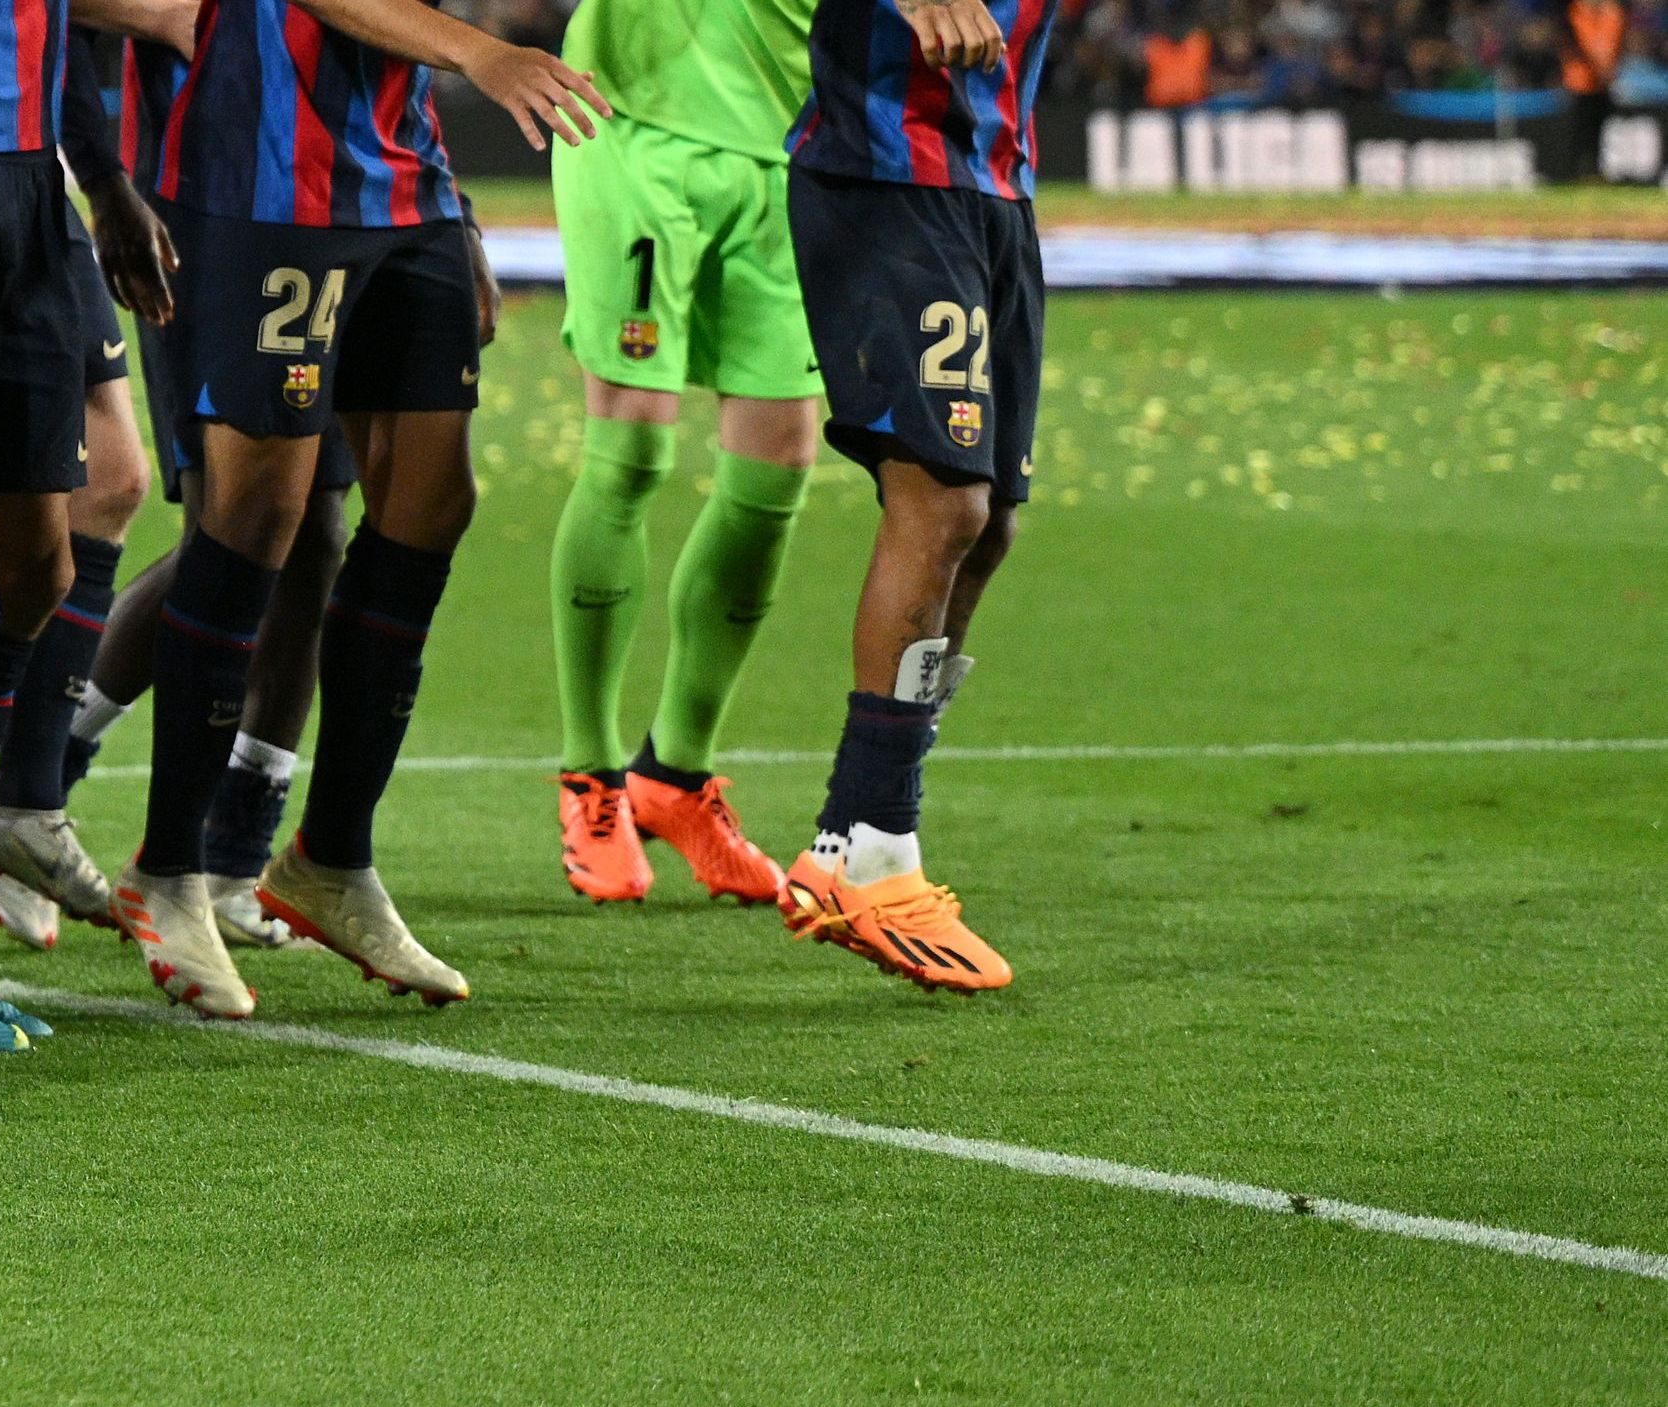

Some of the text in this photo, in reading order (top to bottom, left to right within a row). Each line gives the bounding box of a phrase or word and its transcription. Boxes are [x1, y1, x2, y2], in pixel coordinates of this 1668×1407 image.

[257, 266, 347, 355] 24
[628, 236, 656, 313] 1
[920, 300, 991, 395] 22
